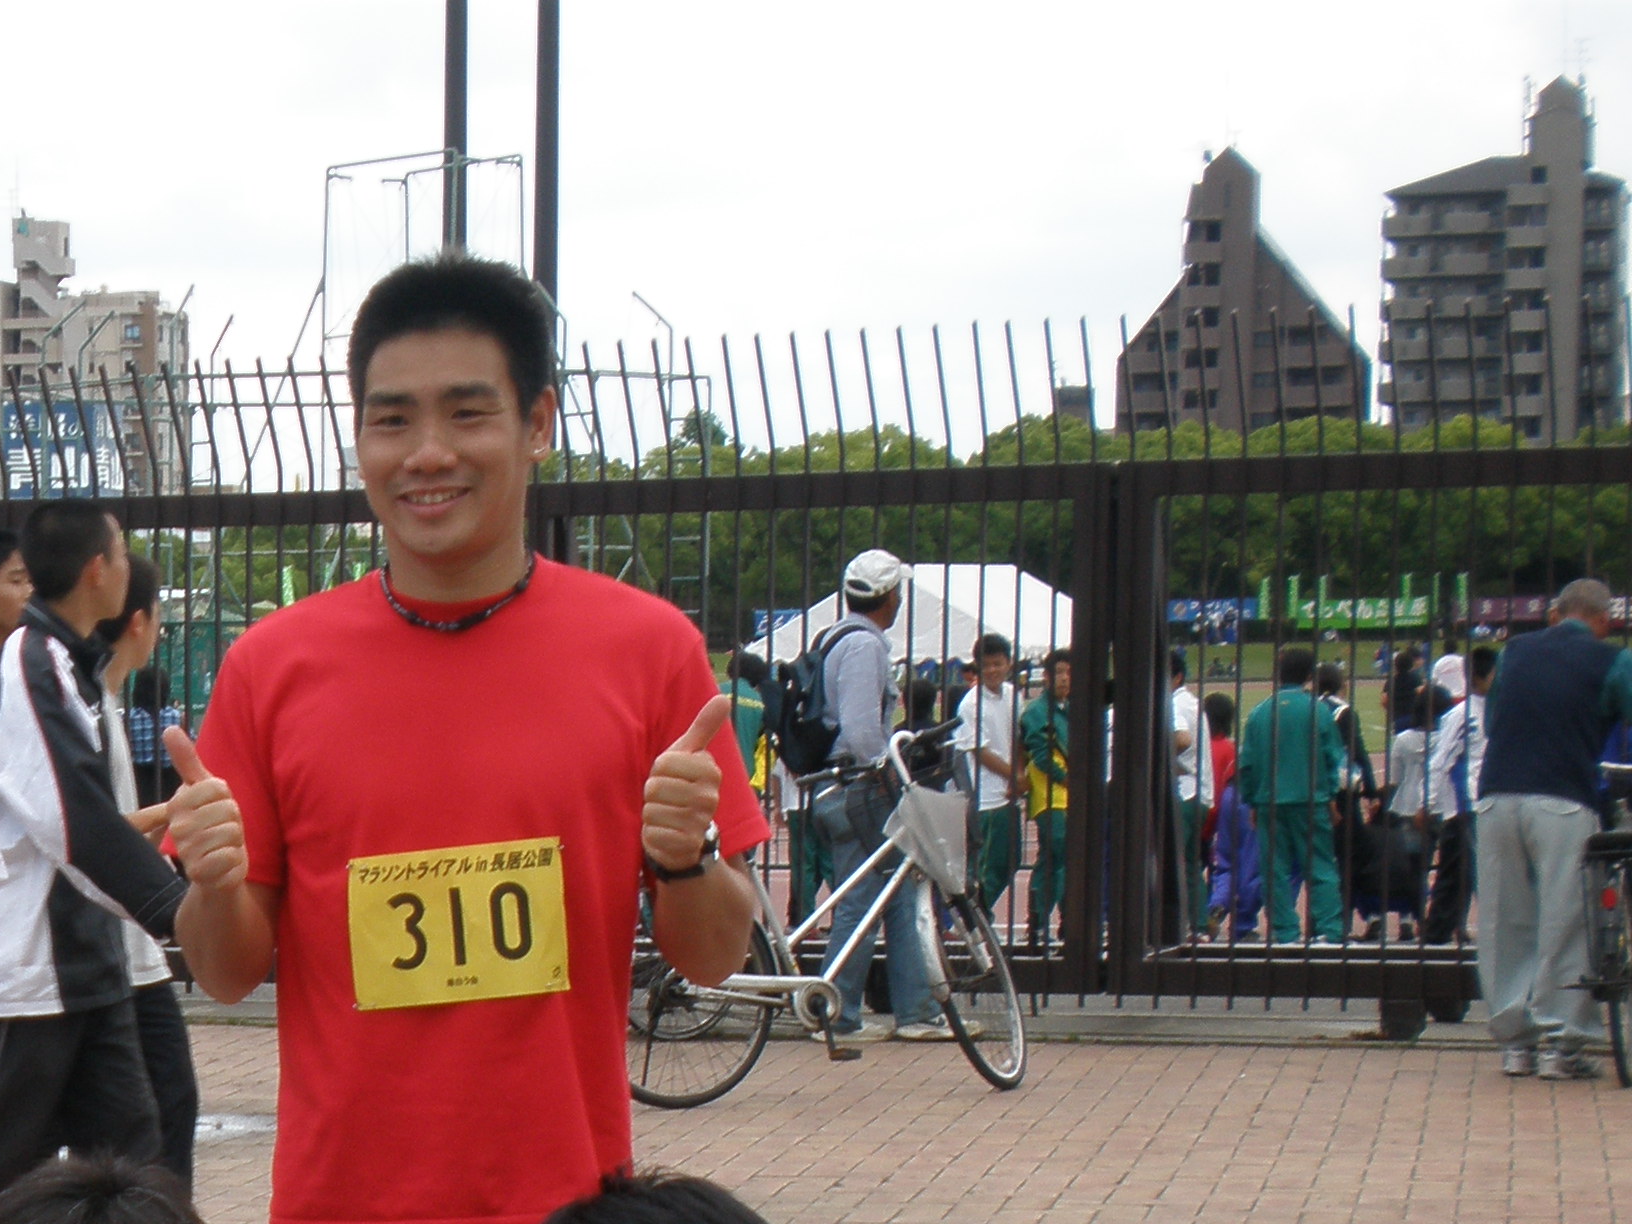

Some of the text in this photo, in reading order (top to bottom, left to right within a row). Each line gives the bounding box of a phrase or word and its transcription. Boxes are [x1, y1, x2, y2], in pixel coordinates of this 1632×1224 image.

[6, 441, 90, 490] 青山
[357, 857, 472, 885] マラソントライアル
[490, 848, 553, 872] 長居公園
[388, 881, 534, 972] 310
